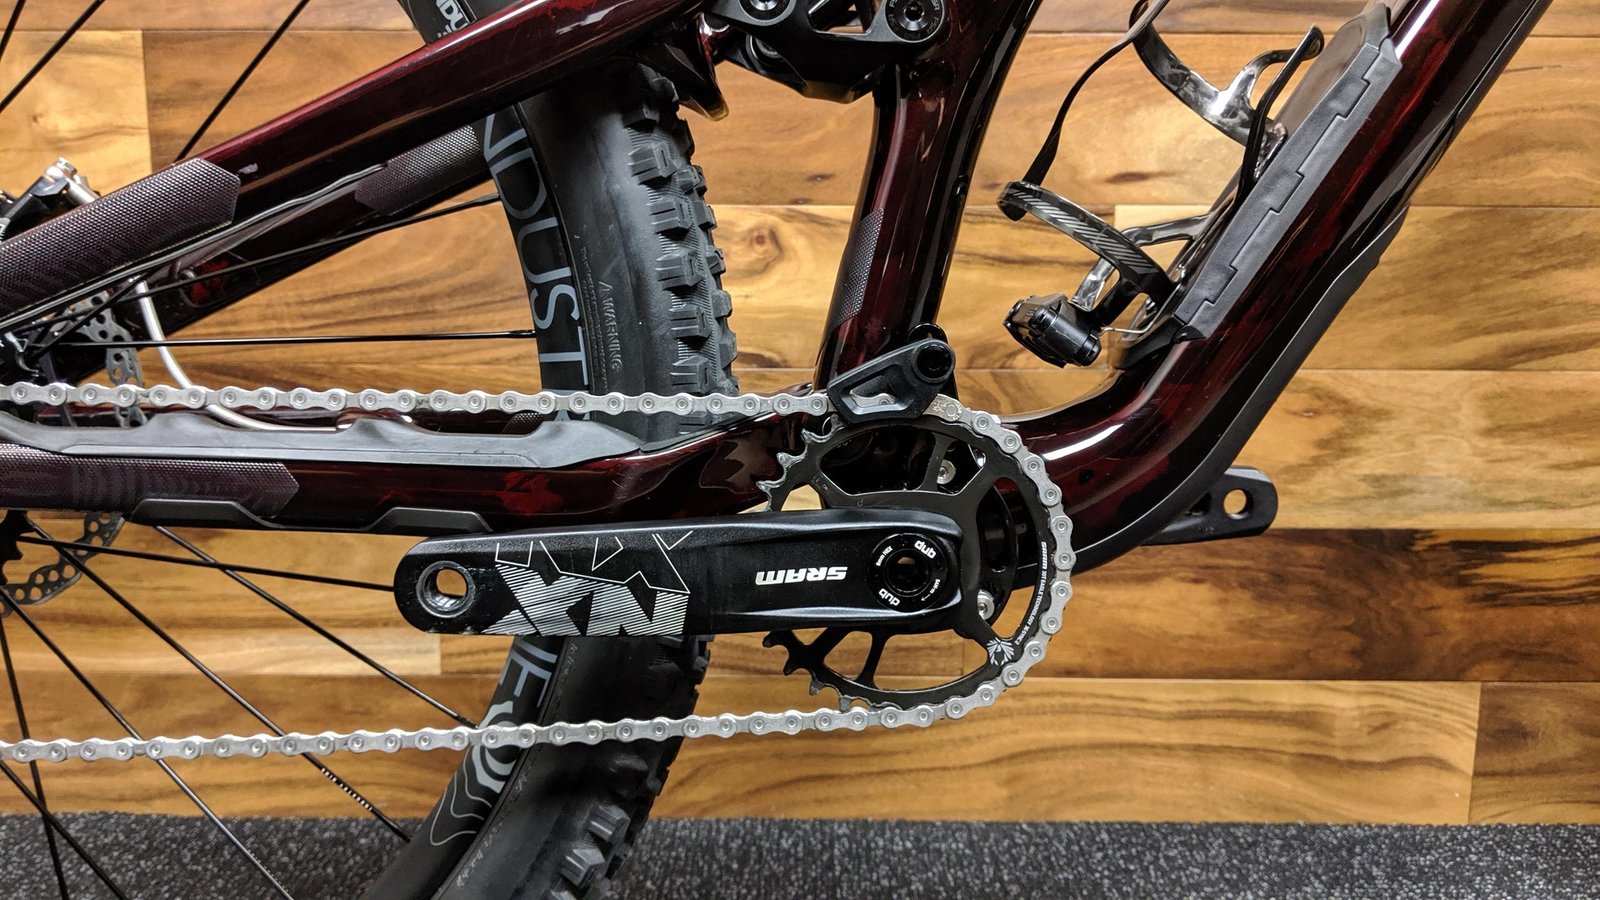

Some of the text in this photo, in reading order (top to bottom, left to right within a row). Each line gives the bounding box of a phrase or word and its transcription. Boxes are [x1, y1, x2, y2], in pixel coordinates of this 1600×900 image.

[914, 540, 937, 559] dub
[755, 566, 848, 585] SRAM
[878, 588, 901, 606] dub
